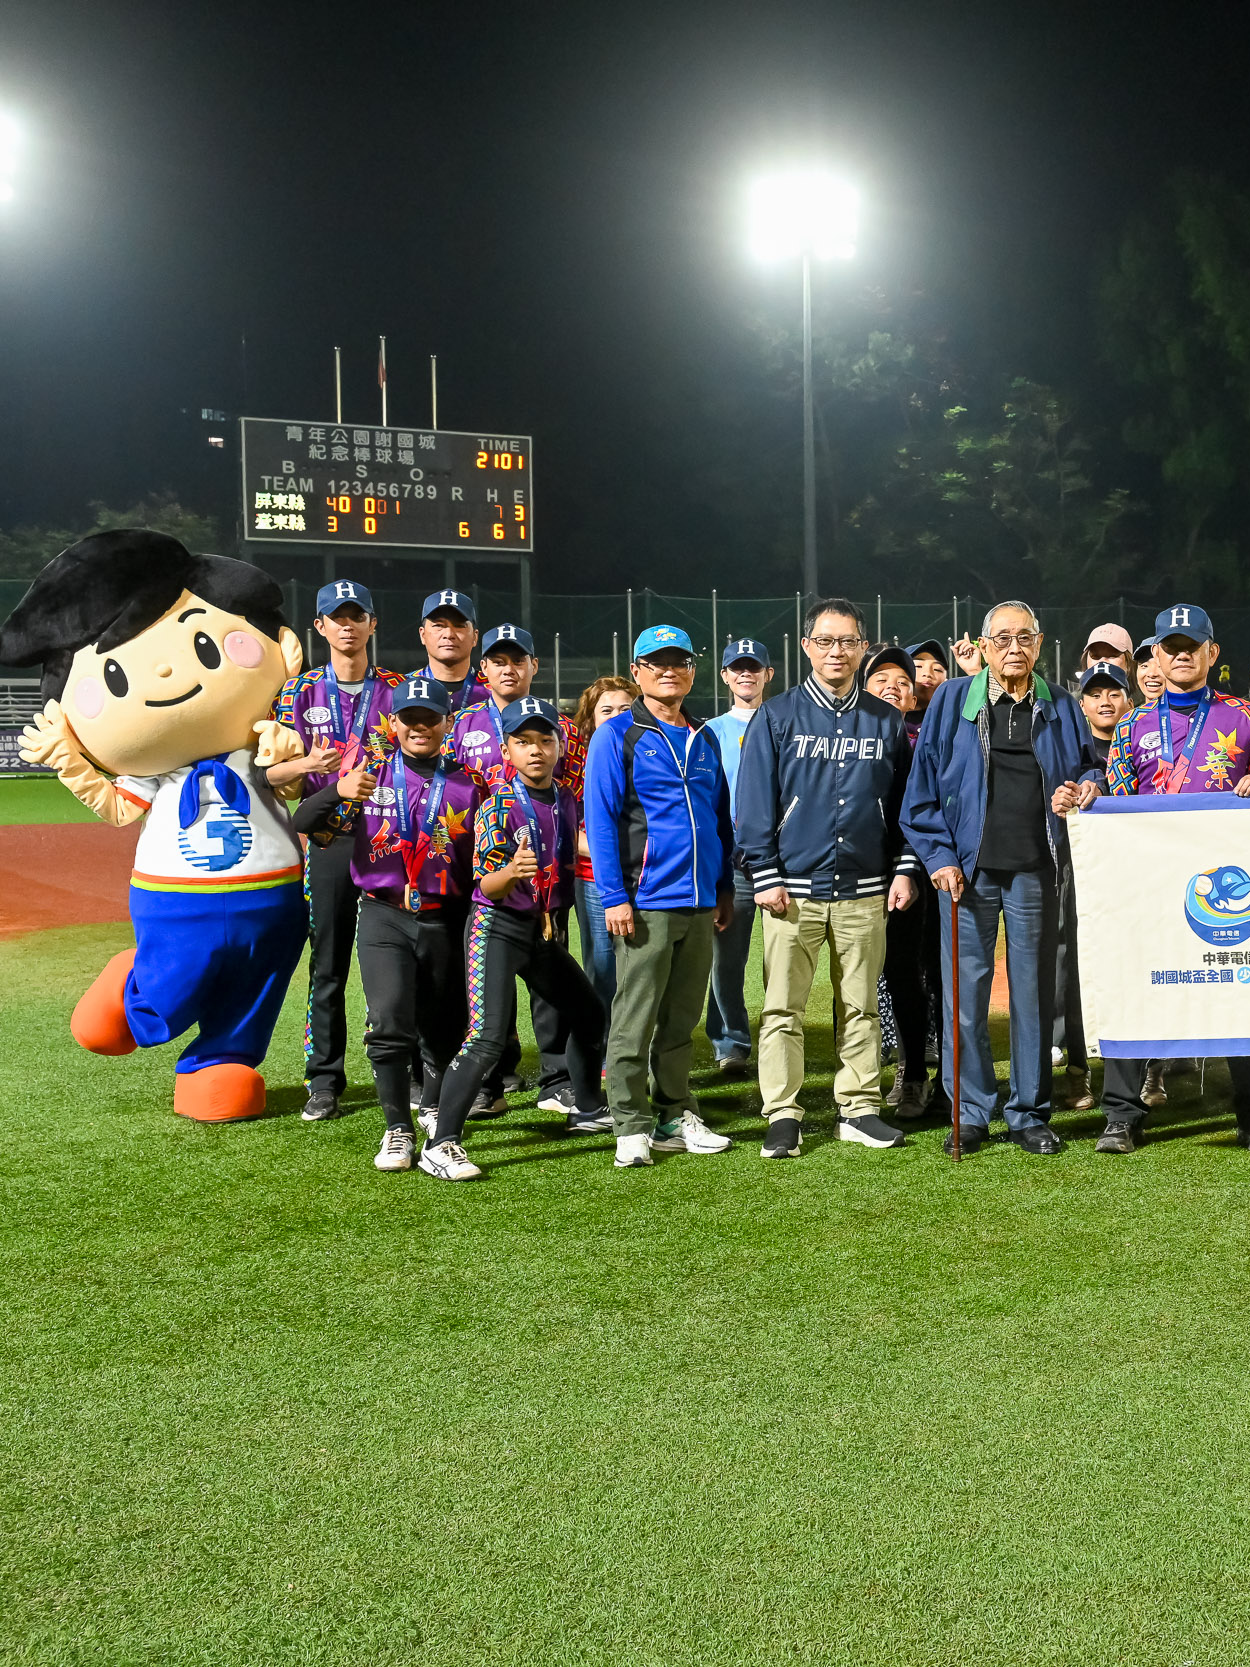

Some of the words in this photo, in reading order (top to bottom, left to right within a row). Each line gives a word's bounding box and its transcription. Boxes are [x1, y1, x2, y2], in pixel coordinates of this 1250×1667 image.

[286, 426, 435, 450] 青年公園謝國城
[477, 439, 520, 452] TIME
[308, 444, 415, 466] 紀念棒球場
[476, 451, 523, 470] 2101
[282, 460, 295, 474] B
[356, 465, 368, 478] S
[410, 468, 424, 481] O
[261, 476, 314, 494] TEAM
[451, 486, 463, 501] R
[487, 488, 498, 502] H
[514, 490, 524, 504] E
[514, 504, 525, 521] 3
[327, 515, 338, 532] 3
[364, 516, 377, 534] 0
[458, 522, 470, 538] 6
[493, 523, 504, 540] 6
[520, 525, 526, 539] 1
[335, 582, 357, 599] H
[439, 590, 459, 606] H
[1170, 607, 1191, 628] H
[497, 625, 517, 640] H
[737, 639, 754, 654] H
[1093, 663, 1111, 675] H
[407, 679, 430, 700] H
[520, 697, 544, 715] H
[794, 735, 883, 760] TAIPEI
[1151, 969, 1234, 985] 謝國城盃全國
